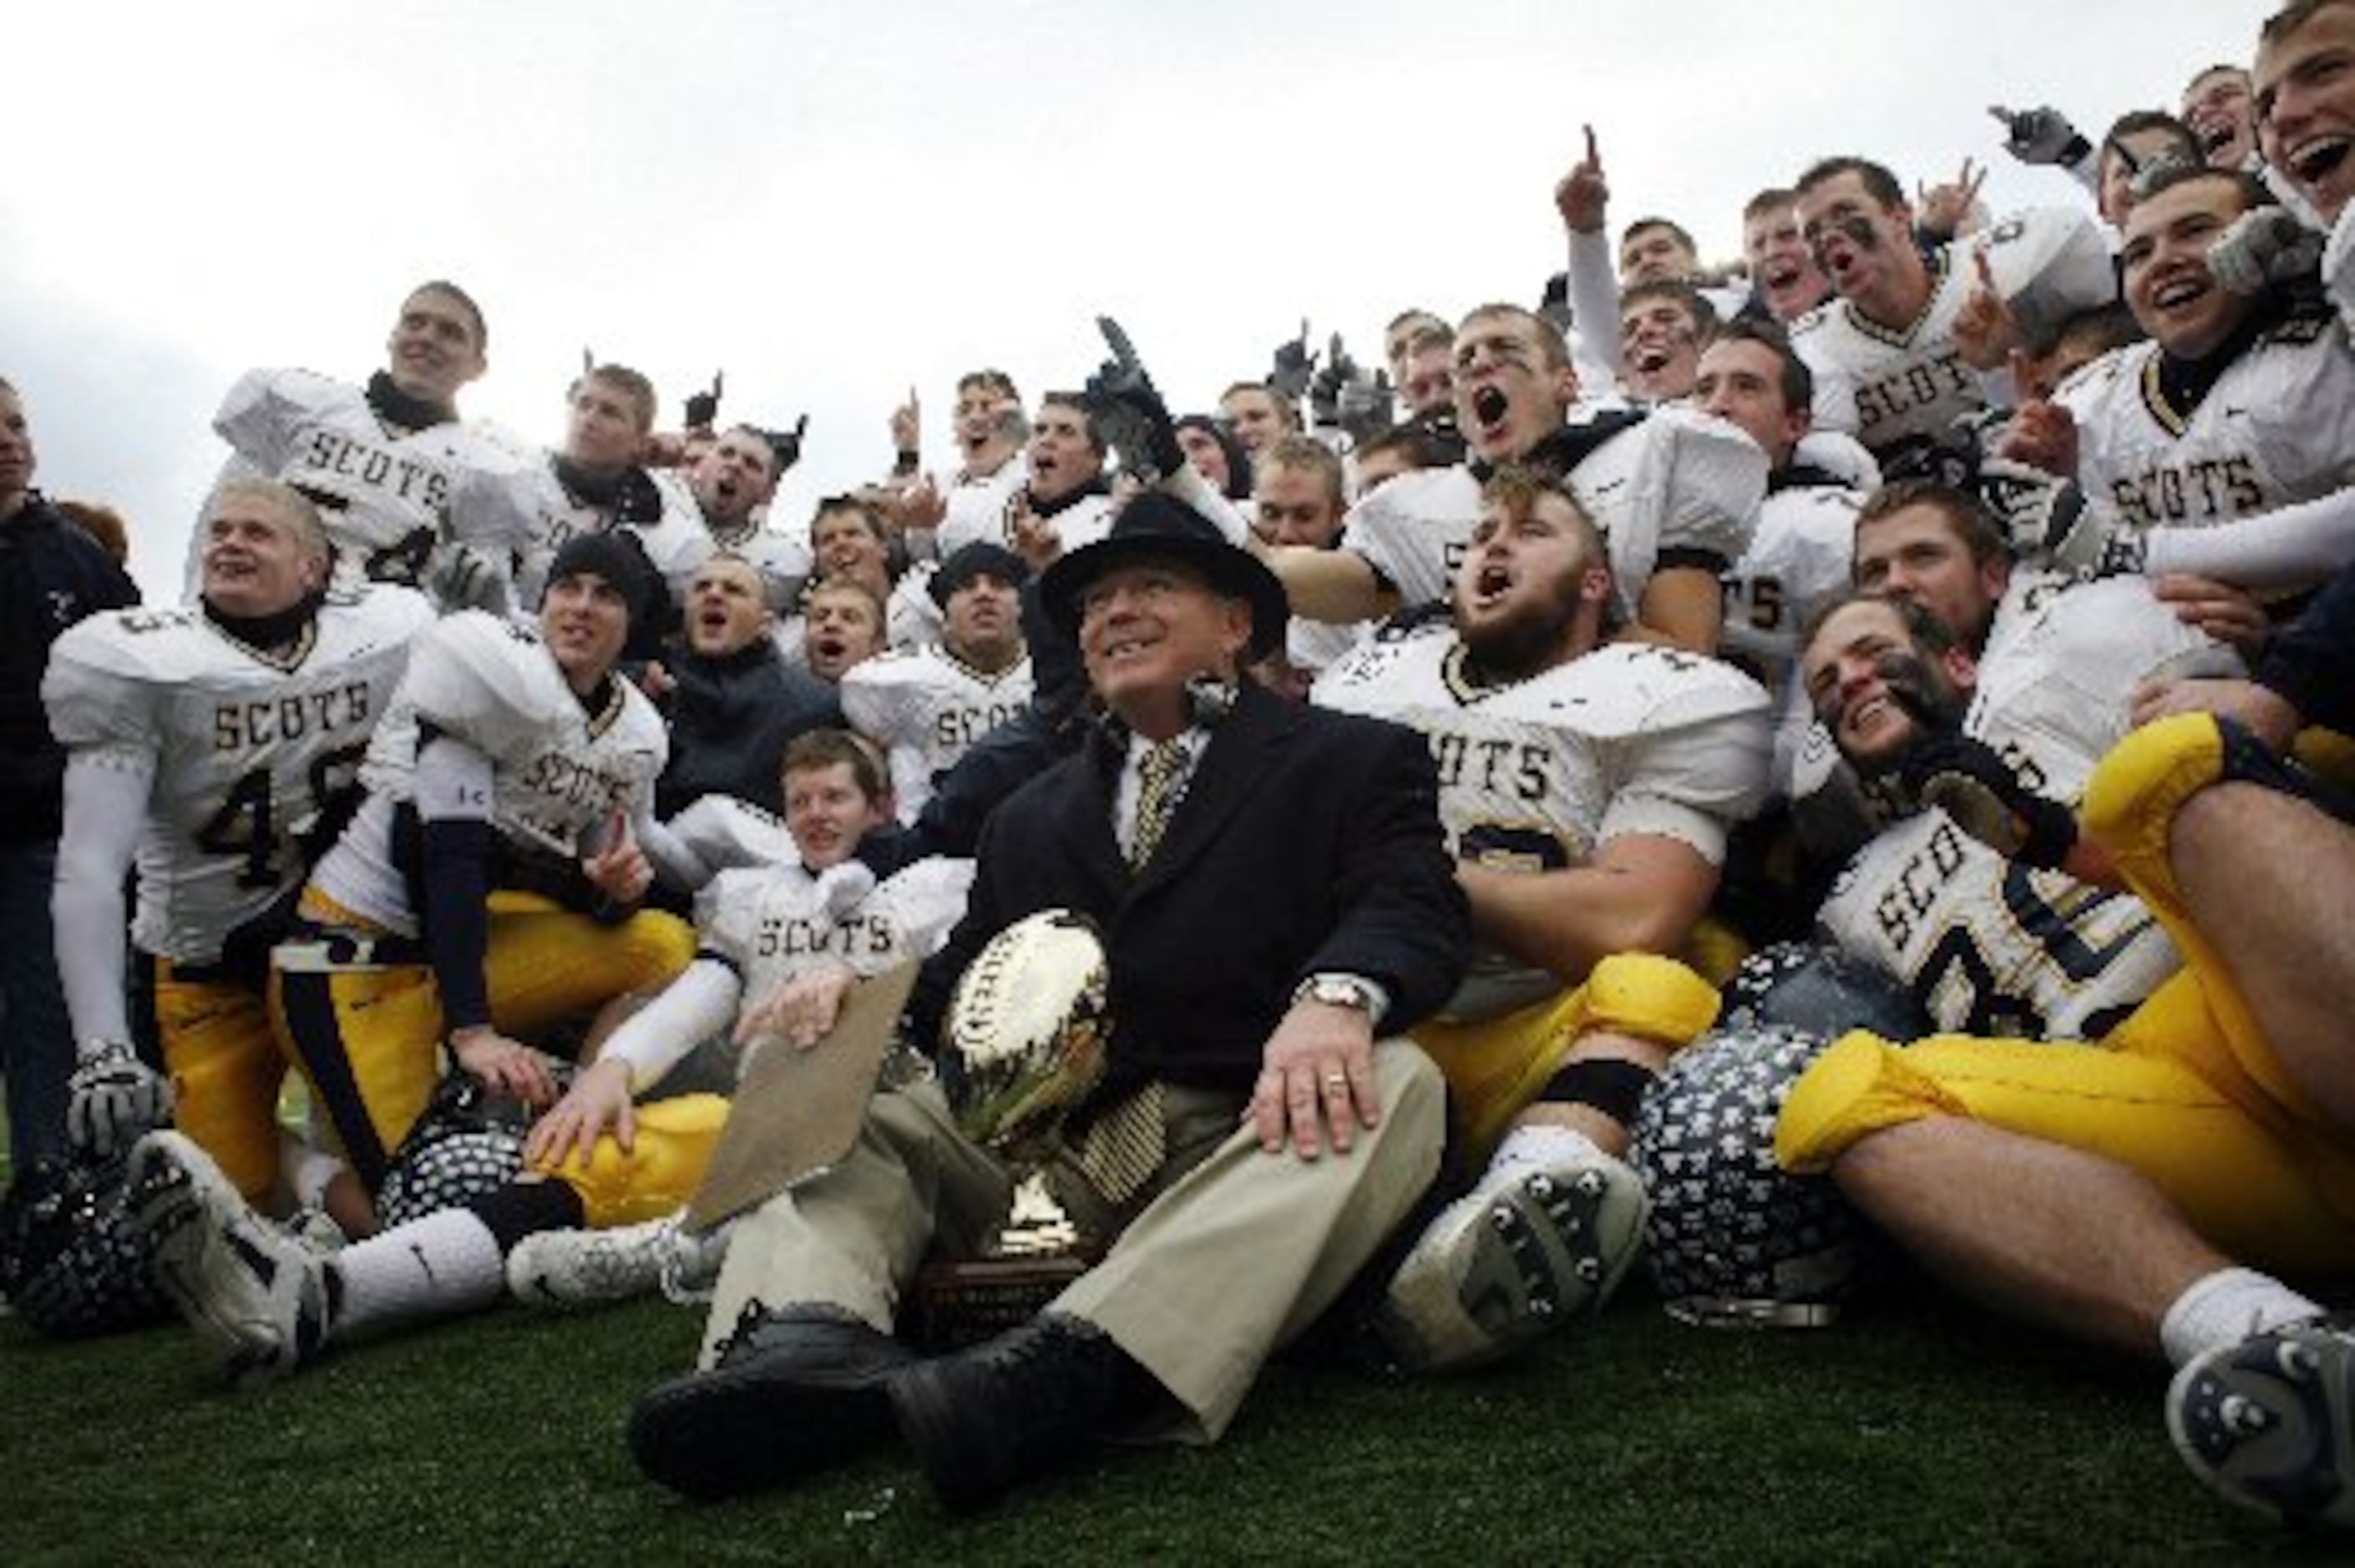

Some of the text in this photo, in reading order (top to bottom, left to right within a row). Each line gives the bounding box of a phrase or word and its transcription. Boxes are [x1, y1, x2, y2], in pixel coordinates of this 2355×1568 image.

[1854, 349, 1966, 427] SCOT
[309, 432, 448, 510] SCOTS
[215, 680, 369, 750] SCOTS
[937, 703, 1027, 746] SCO
[1435, 734, 1550, 799] OTS
[1876, 823, 1963, 950] SCO
